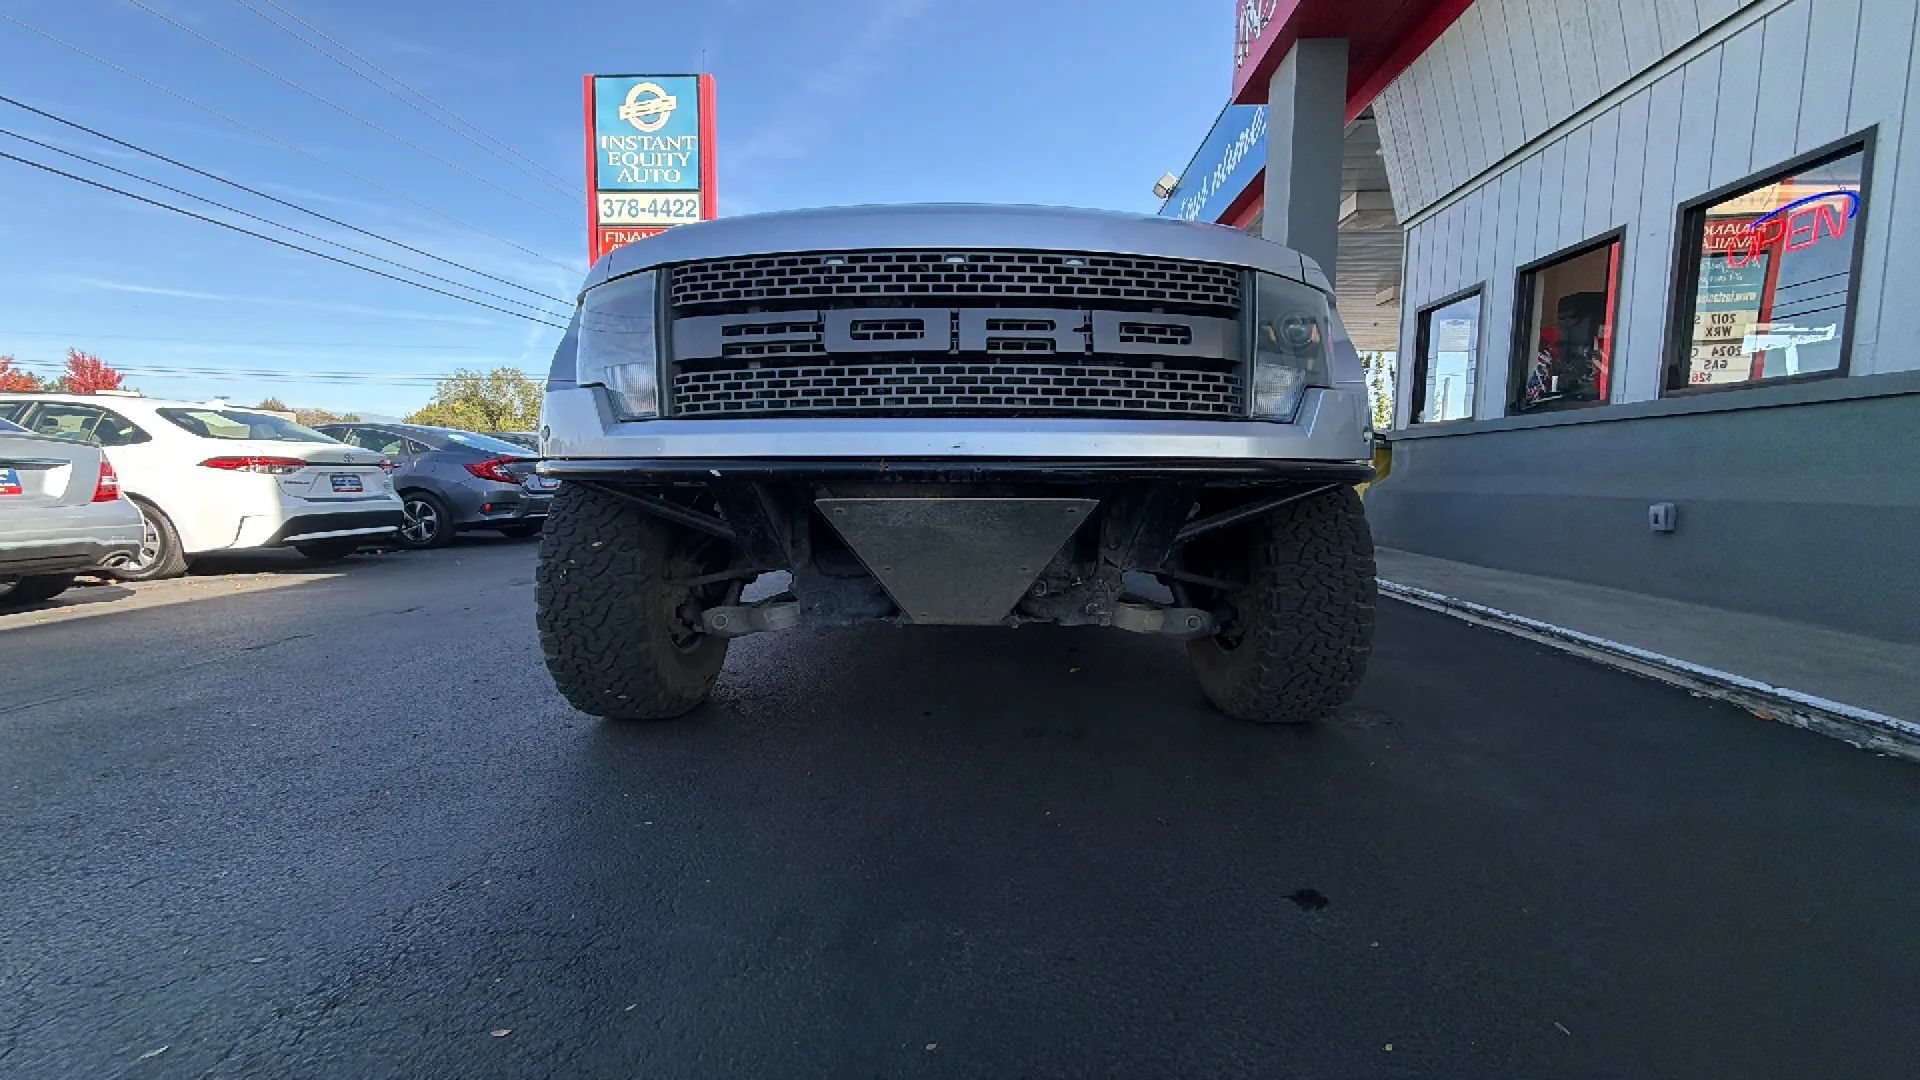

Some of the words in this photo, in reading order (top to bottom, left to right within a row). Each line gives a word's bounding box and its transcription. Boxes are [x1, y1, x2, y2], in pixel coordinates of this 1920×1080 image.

[601, 135, 697, 150] INSTANT
[608, 151, 691, 168] EQUITY
[617, 168, 681, 183] AUTO
[603, 198, 697, 218] 378-4422
[1727, 196, 1850, 269] OPEN
[673, 308, 1240, 363] FORD
